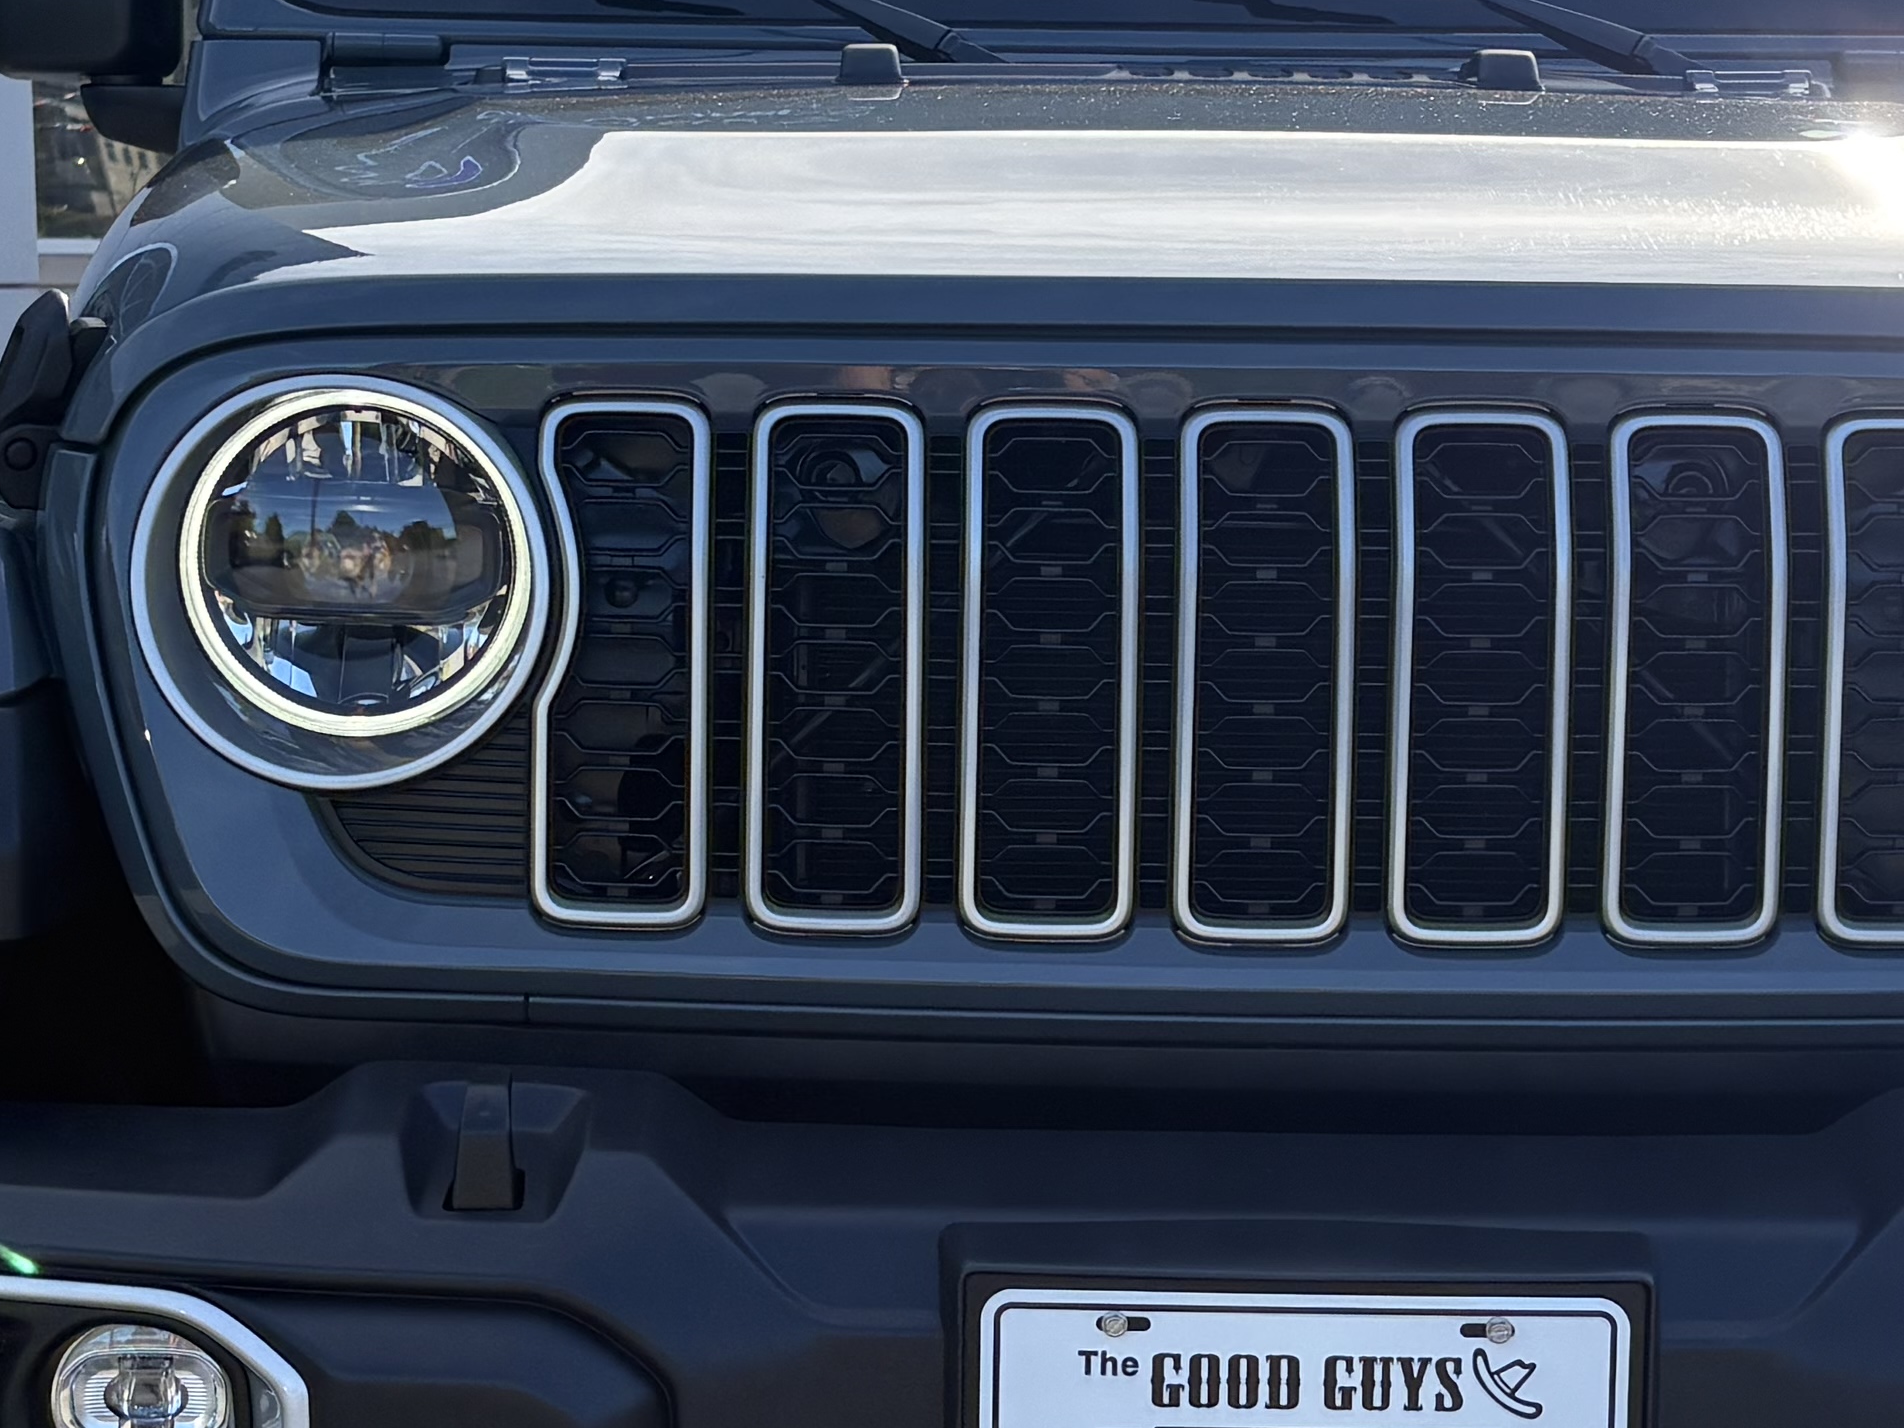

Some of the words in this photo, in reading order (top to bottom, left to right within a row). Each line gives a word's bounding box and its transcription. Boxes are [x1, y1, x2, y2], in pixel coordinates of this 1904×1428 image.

[1077, 1349, 1140, 1377] The
[1149, 1351, 1302, 1411] GOOD
[1322, 1354, 1464, 1413] GUYS
